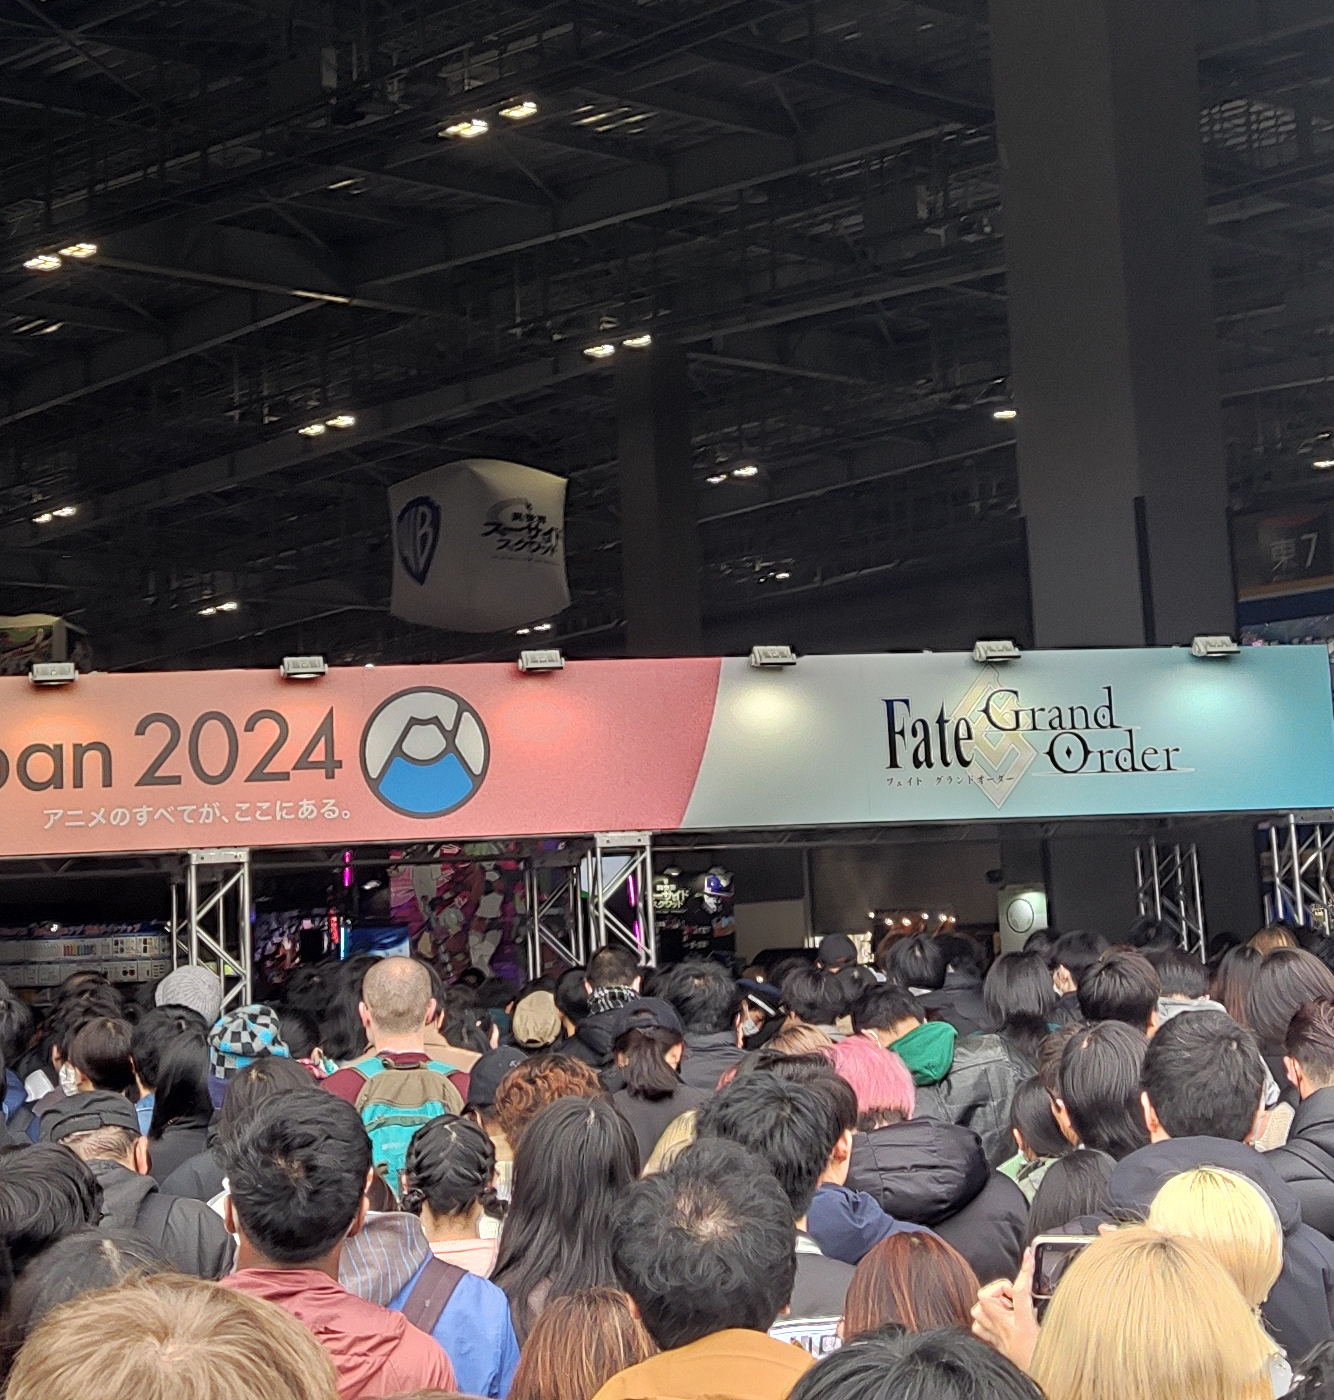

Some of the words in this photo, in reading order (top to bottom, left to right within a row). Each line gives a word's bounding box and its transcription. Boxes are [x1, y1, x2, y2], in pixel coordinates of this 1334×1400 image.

[977, 685, 1123, 731] Grand
[134, 706, 343, 787] 2024
[881, 697, 976, 770] Fate
[1042, 729, 1181, 774] Order
[43, 799, 351, 829] アニメのすべてが、ここにある。
